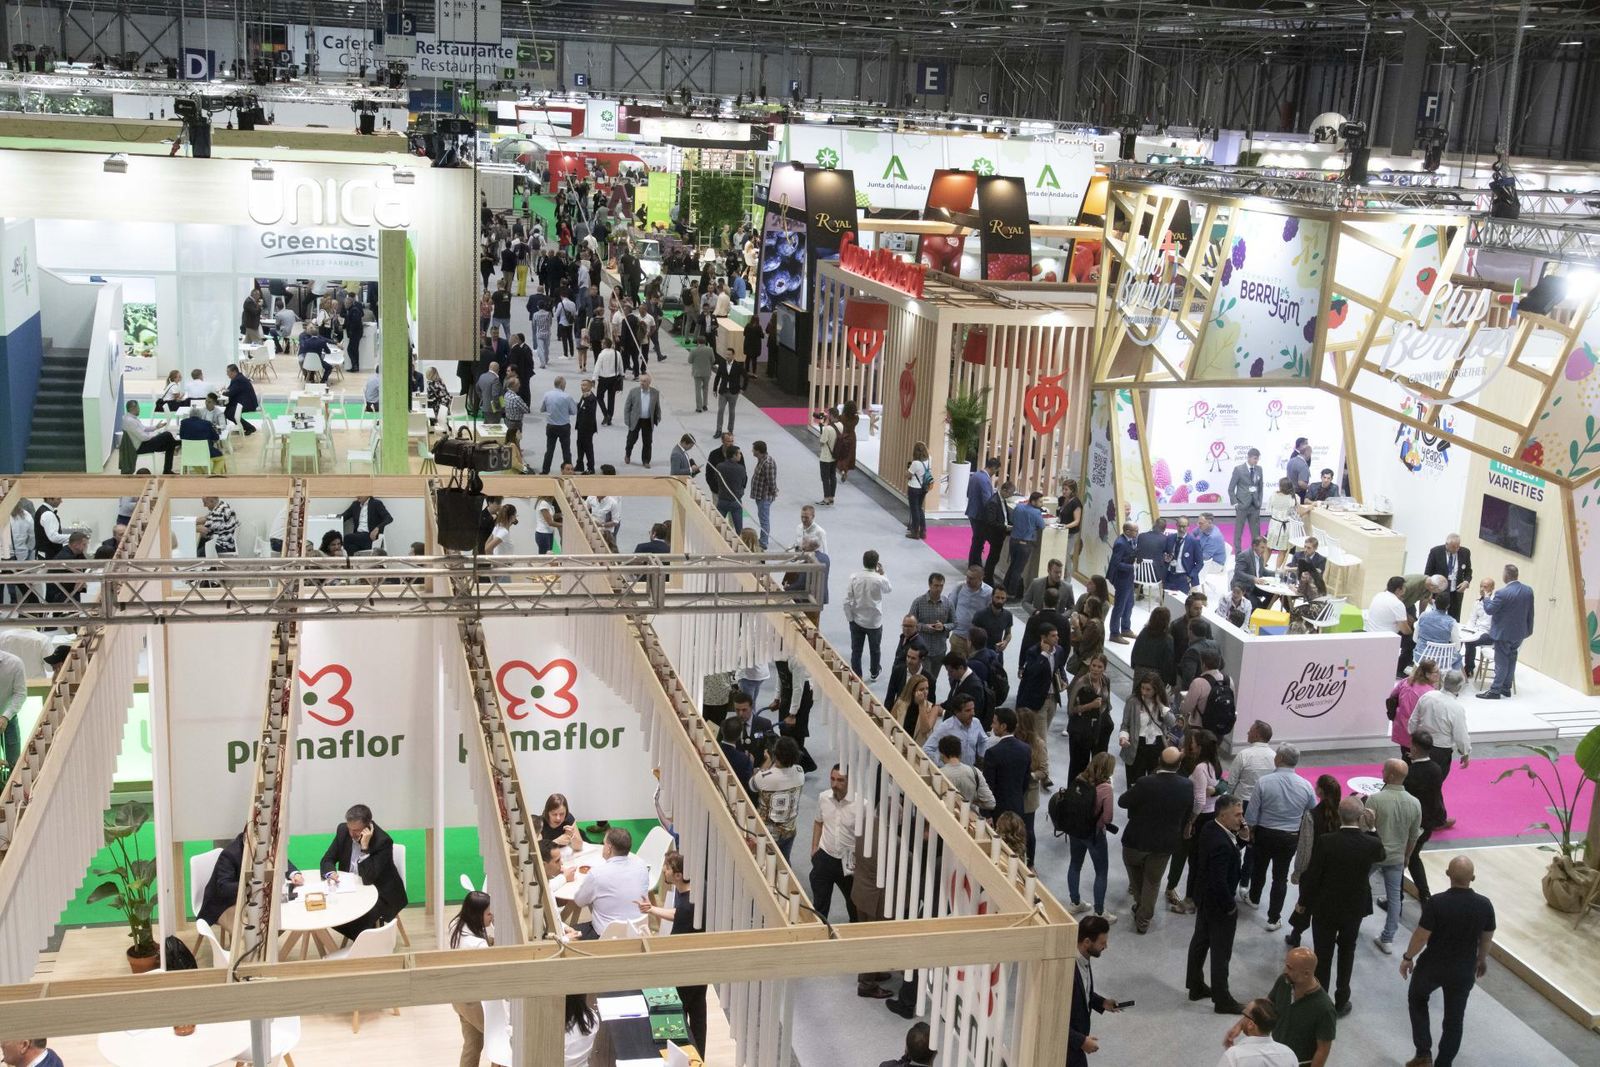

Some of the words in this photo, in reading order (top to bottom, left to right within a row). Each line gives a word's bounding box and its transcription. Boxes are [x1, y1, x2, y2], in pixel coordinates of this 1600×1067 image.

[281, 52, 290, 62] D
[416, 40, 513, 59] Restaurante
[186, 53, 208, 79] D
[577, 75, 584, 86] E
[792, 81, 799, 90] F
[925, 67, 939, 90] E
[979, 94, 988, 104] G
[1425, 96, 1438, 118] F
[867, 181, 886, 190] Junta
[260, 231, 377, 252] Greentast
[1418, 283, 1493, 327] Plus
[1407, 369, 1449, 384] GROWING
[1488, 471, 1544, 502] VARIETIES
[1299, 661, 1334, 684] Plus
[1280, 679, 1347, 705] Berries
